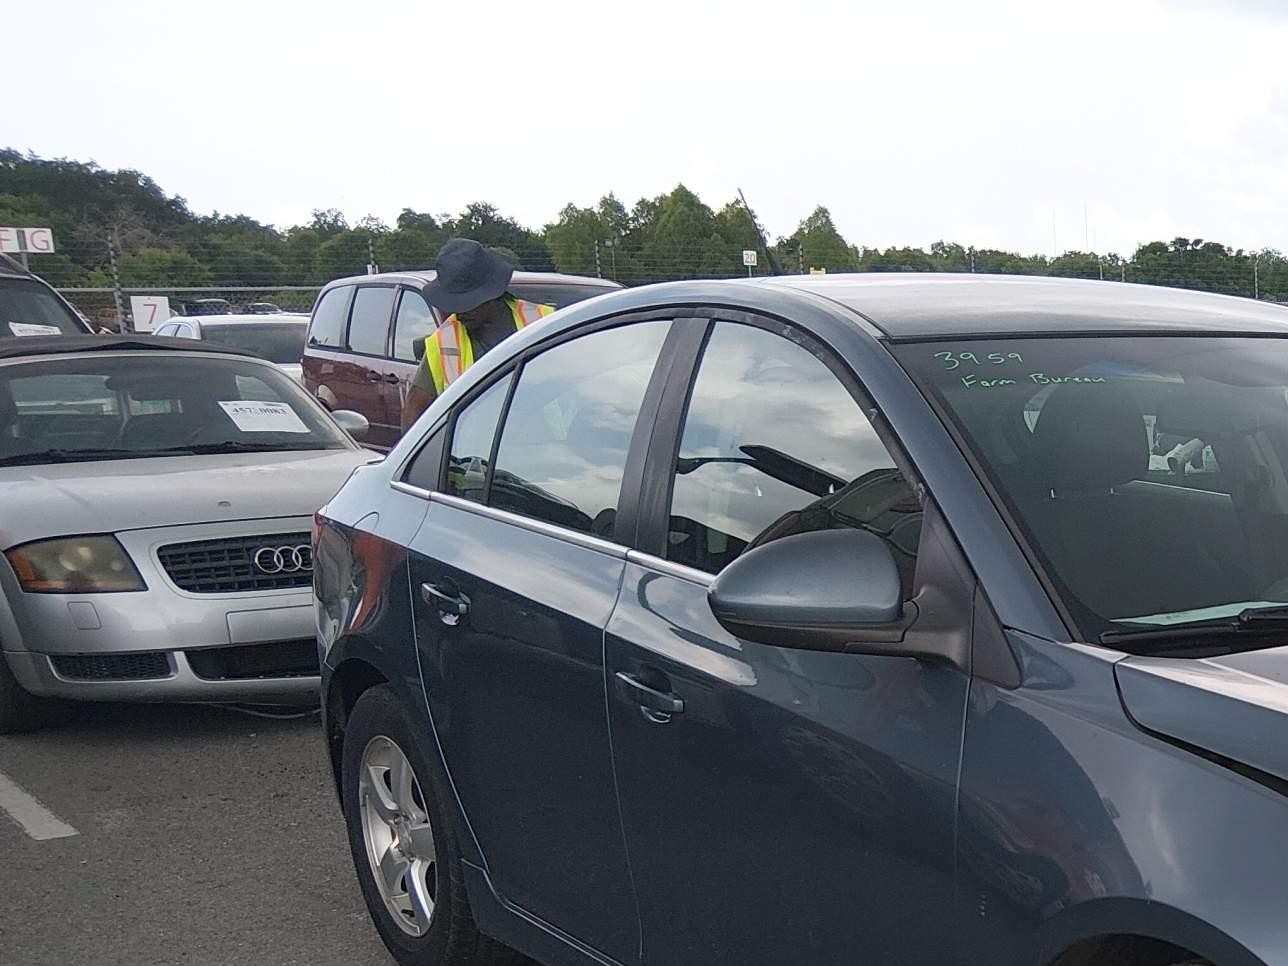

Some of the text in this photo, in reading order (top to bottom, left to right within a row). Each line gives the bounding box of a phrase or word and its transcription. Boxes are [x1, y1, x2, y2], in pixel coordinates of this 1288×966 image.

[30, 229, 50, 251] G
[744, 253, 755, 264] 20
[143, 303, 158, 324] 7
